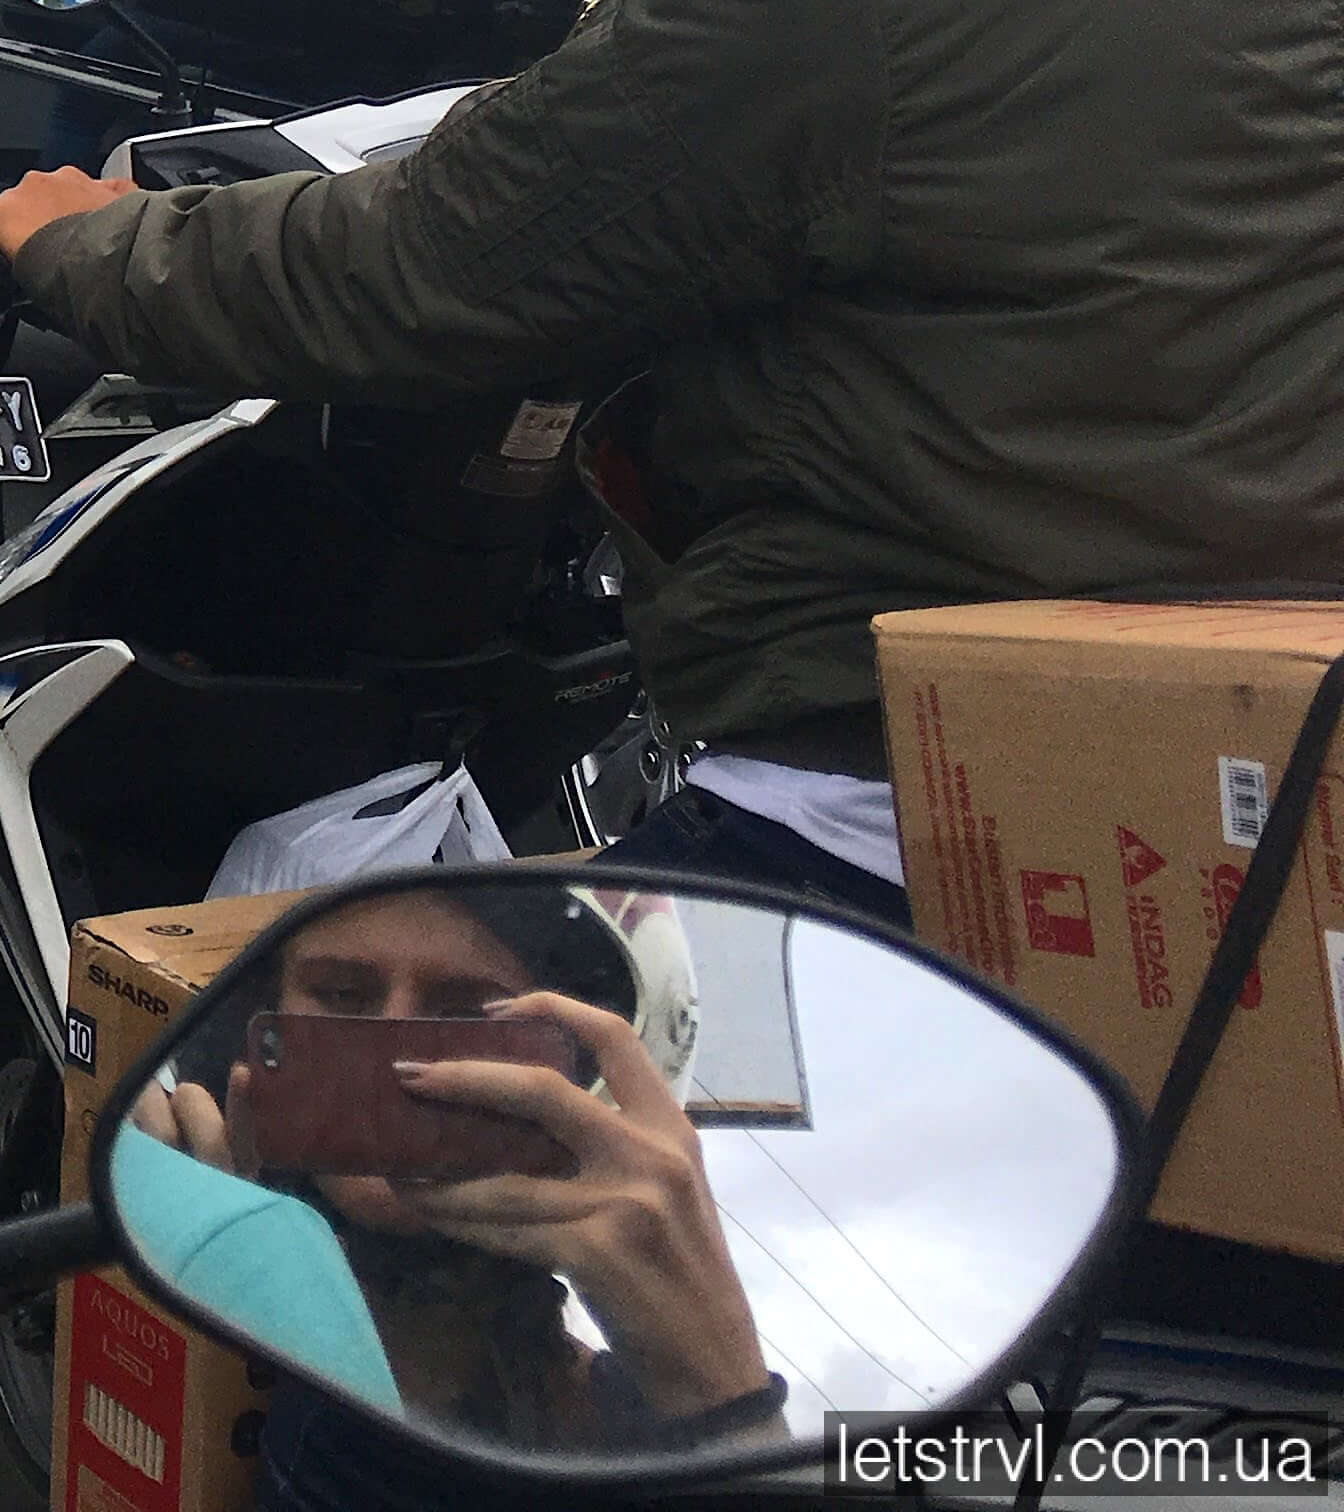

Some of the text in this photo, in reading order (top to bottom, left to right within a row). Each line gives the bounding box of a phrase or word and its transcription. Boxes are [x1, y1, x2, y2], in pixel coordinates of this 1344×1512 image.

[88, 964, 169, 1017] SHARP
[70, 1021, 90, 1059] 10
[91, 1289, 169, 1361] AQUOS
[102, 1334, 153, 1386] LED
